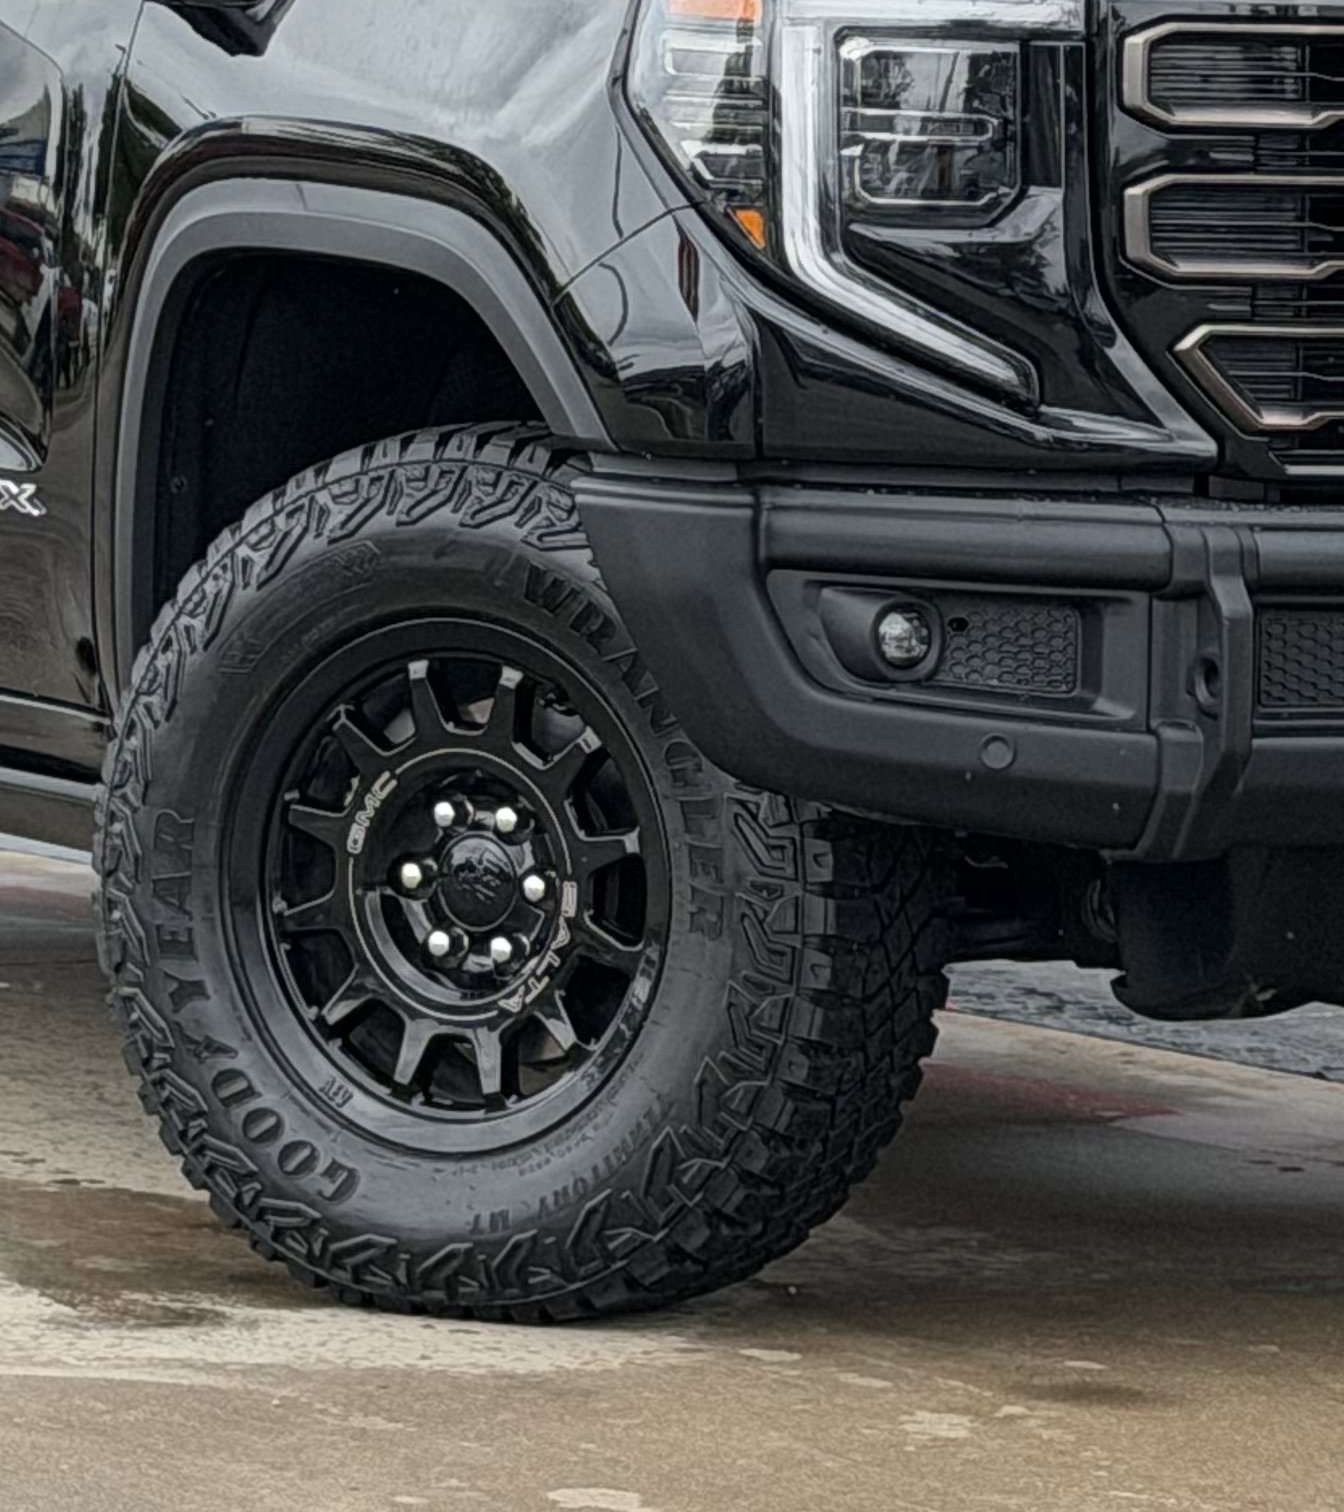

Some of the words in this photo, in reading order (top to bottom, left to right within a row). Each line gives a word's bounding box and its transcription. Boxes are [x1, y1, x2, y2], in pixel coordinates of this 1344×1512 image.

[346, 769, 399, 856] GMC
[523, 562, 727, 941] WRANGLER
[153, 808, 362, 1203] GOODYEAR
